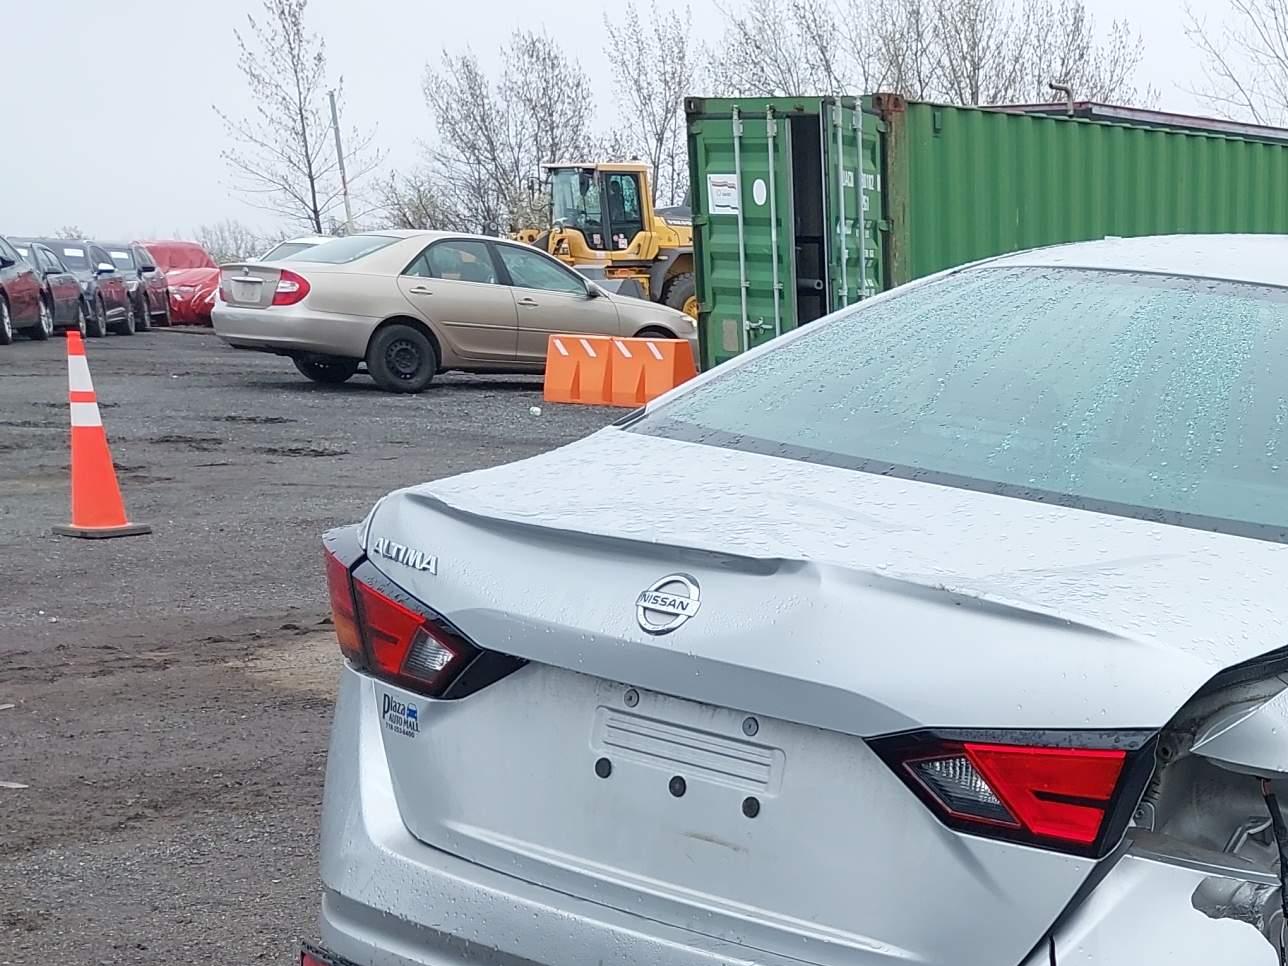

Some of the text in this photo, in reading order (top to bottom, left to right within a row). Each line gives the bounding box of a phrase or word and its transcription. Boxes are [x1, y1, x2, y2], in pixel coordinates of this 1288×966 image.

[373, 537, 438, 575] ALTIMA
[639, 592, 690, 611] NISSAN
[388, 713, 420, 733] AUTO MALL
